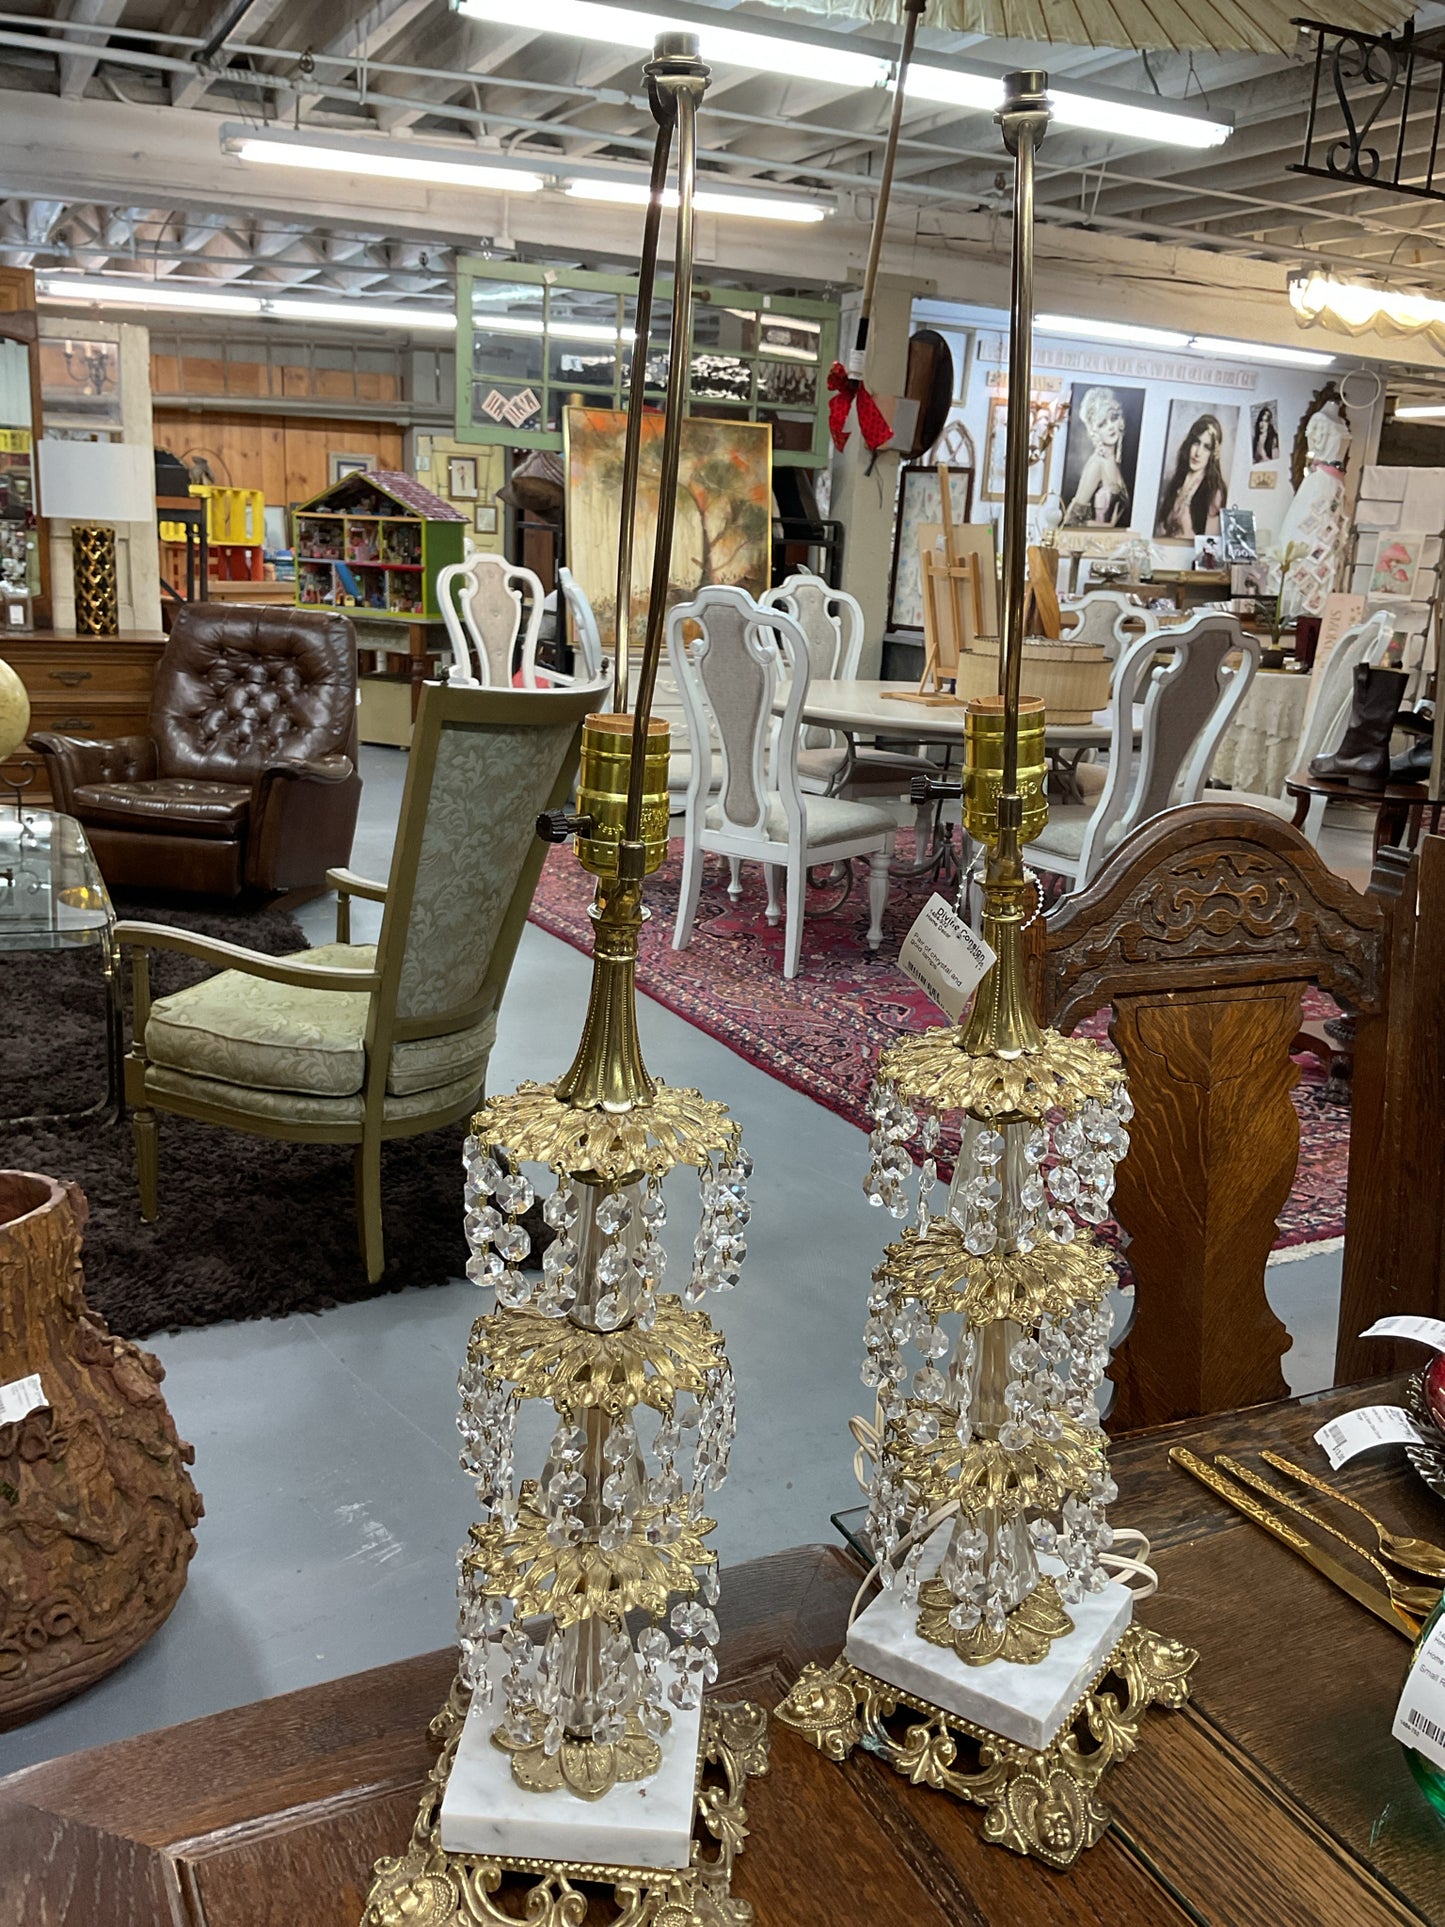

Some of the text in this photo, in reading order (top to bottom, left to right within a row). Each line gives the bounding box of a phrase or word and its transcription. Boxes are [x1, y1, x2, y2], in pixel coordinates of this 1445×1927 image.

[937, 907, 986, 961] Divine Consign
[910, 939, 923, 953] gold
[922, 952, 938, 970] lamps
[914, 932, 925, 947] Pair
[931, 950, 952, 975] chrystal
[951, 973, 962, 987] and
[1419, 1663, 1439, 1682] Small
[1426, 1650, 1444, 1666] Home
